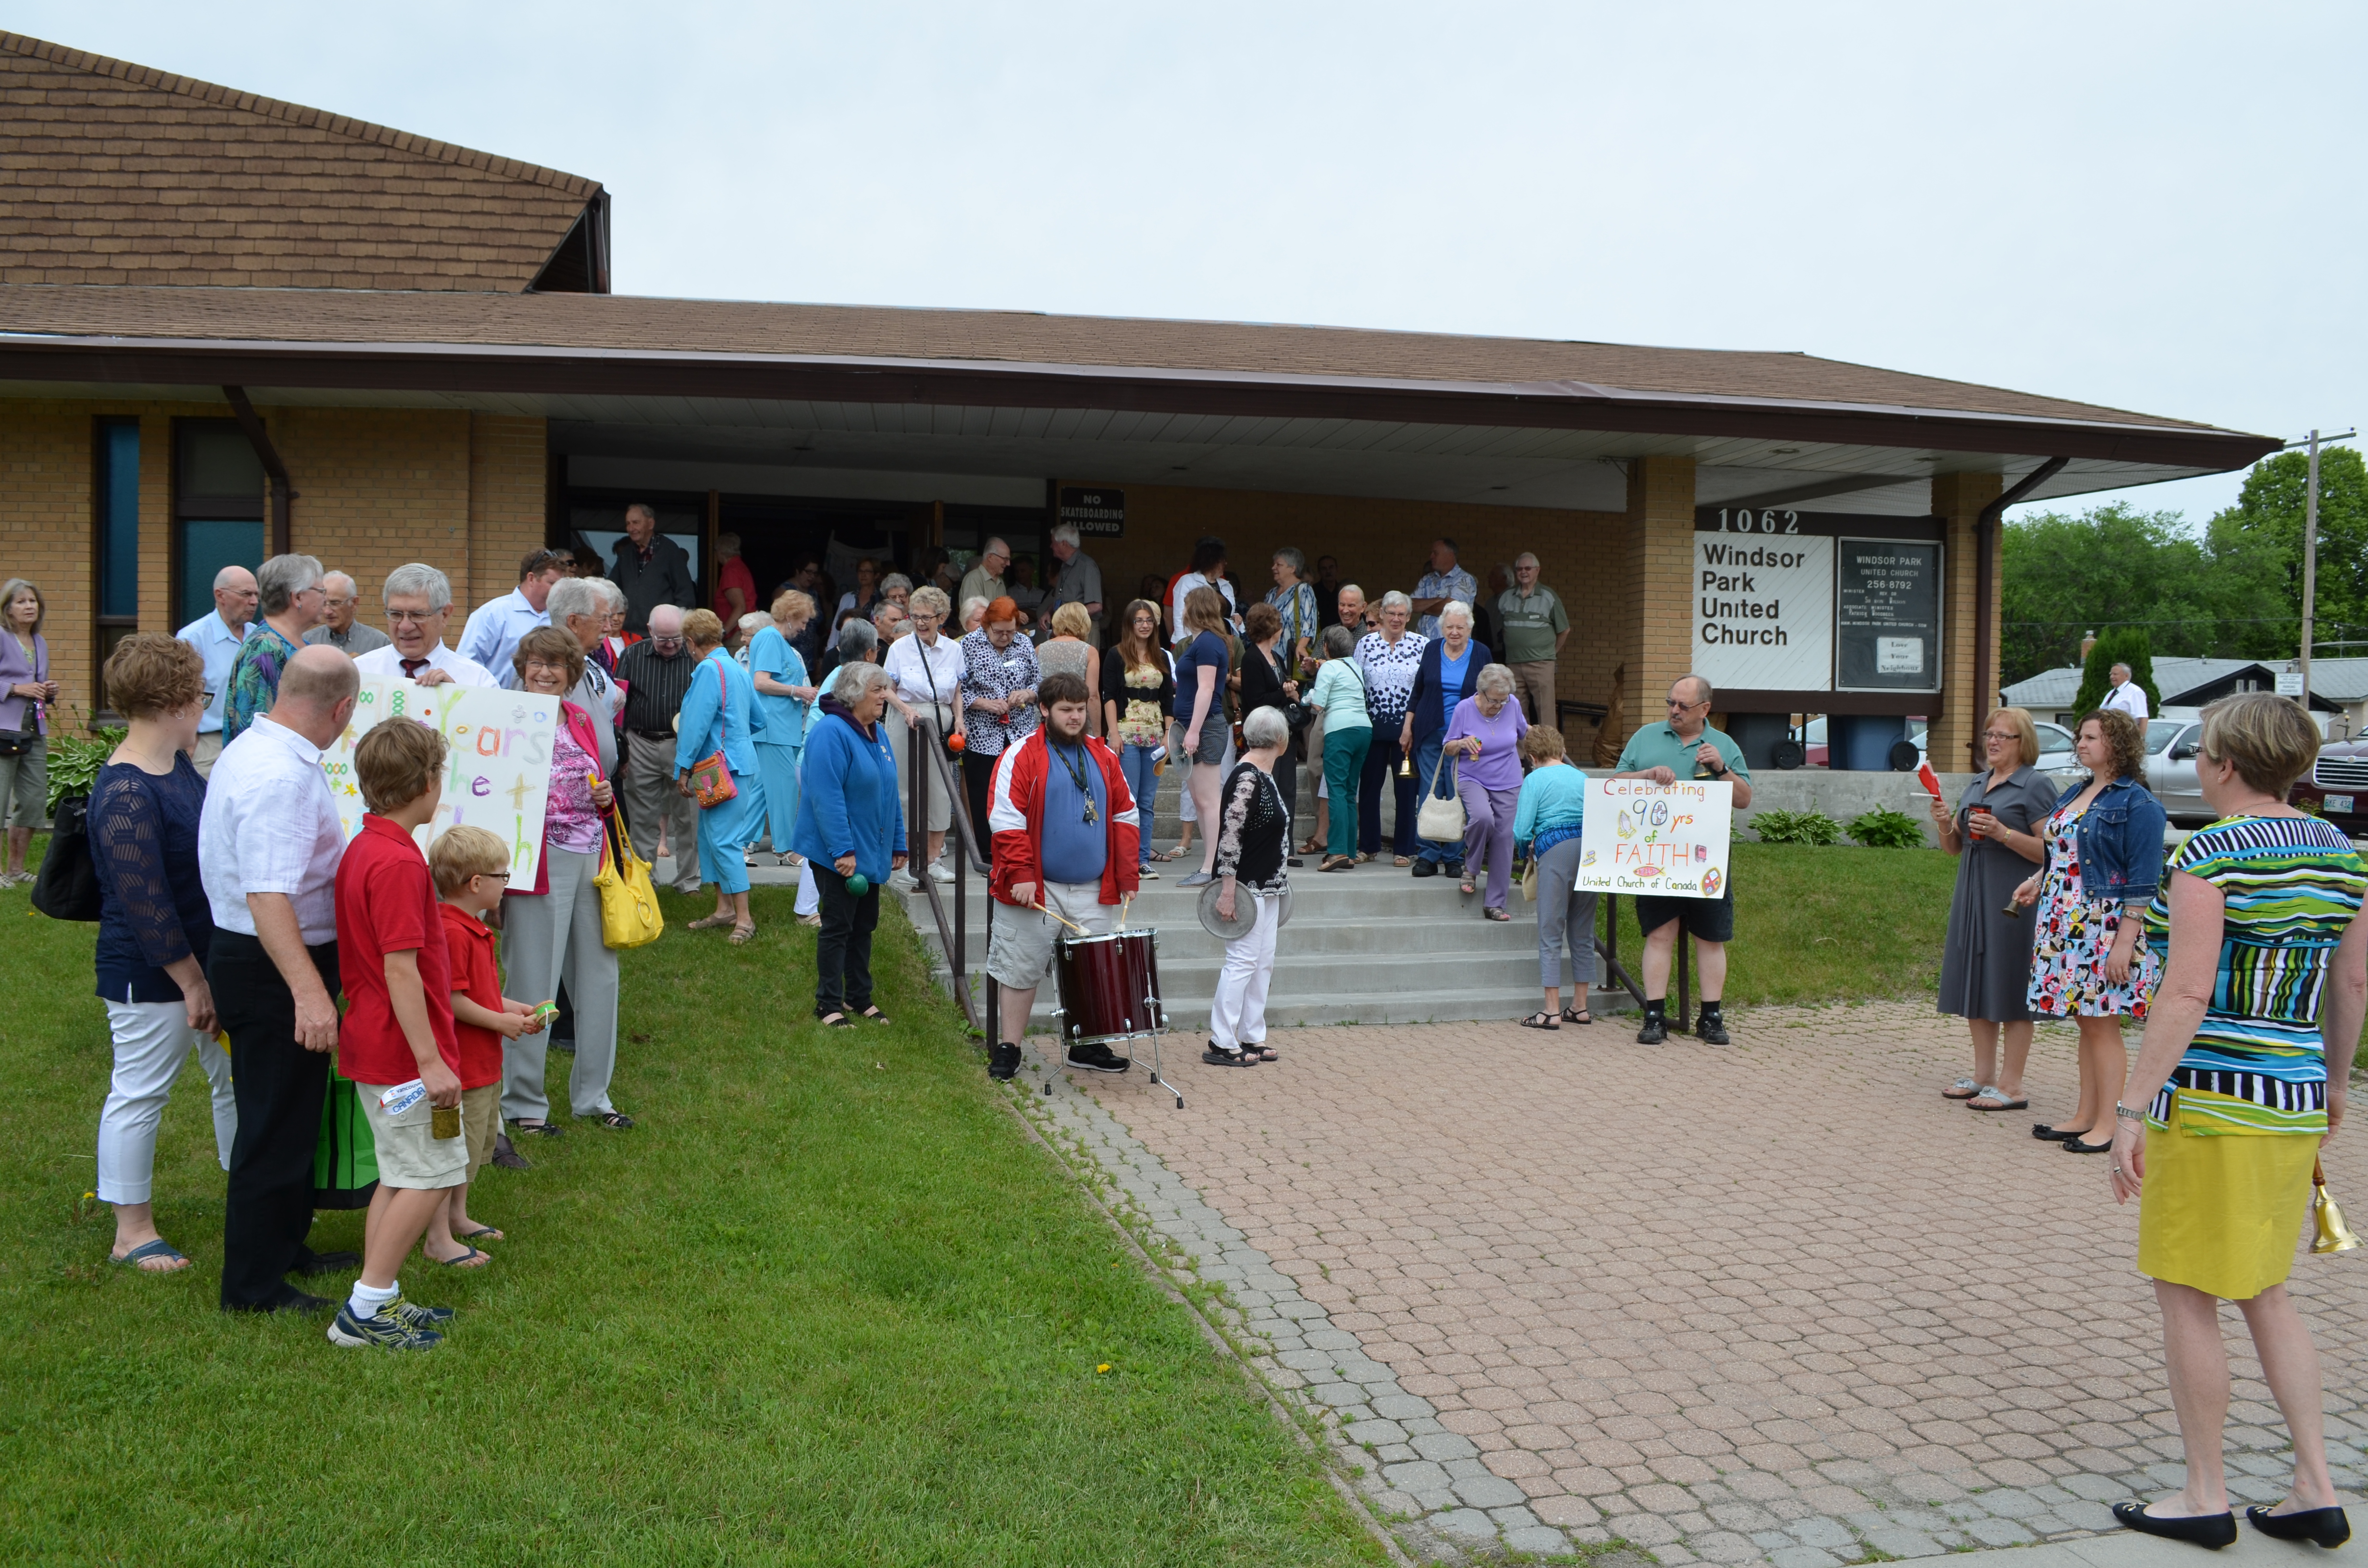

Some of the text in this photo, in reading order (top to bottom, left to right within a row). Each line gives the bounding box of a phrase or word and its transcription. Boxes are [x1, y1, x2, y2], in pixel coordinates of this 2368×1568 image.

[1084, 495, 1101, 504] NO
[1061, 507, 1123, 519] SKATEBOARDING
[1718, 508, 1799, 534] 1062
[1703, 543, 1805, 568] Windsor
[1857, 556, 1922, 565] WINDSOR PARK
[1702, 570, 1755, 592] Park
[1867, 580, 1912, 589] 256-8792
[1702, 597, 1779, 619] United
[1702, 622, 1788, 646] Church
[435, 685, 550, 765] Years
[1603, 779, 1705, 802] Celebrating
[2340, 800, 2351, 808] 432
[1632, 799, 1693, 833] 90 yrs
[1644, 830, 1658, 843] of
[1615, 843, 1689, 867] FAITH
[1583, 876, 1697, 891] United Church of Canada
[393, 1087, 426, 1113] CANADA
